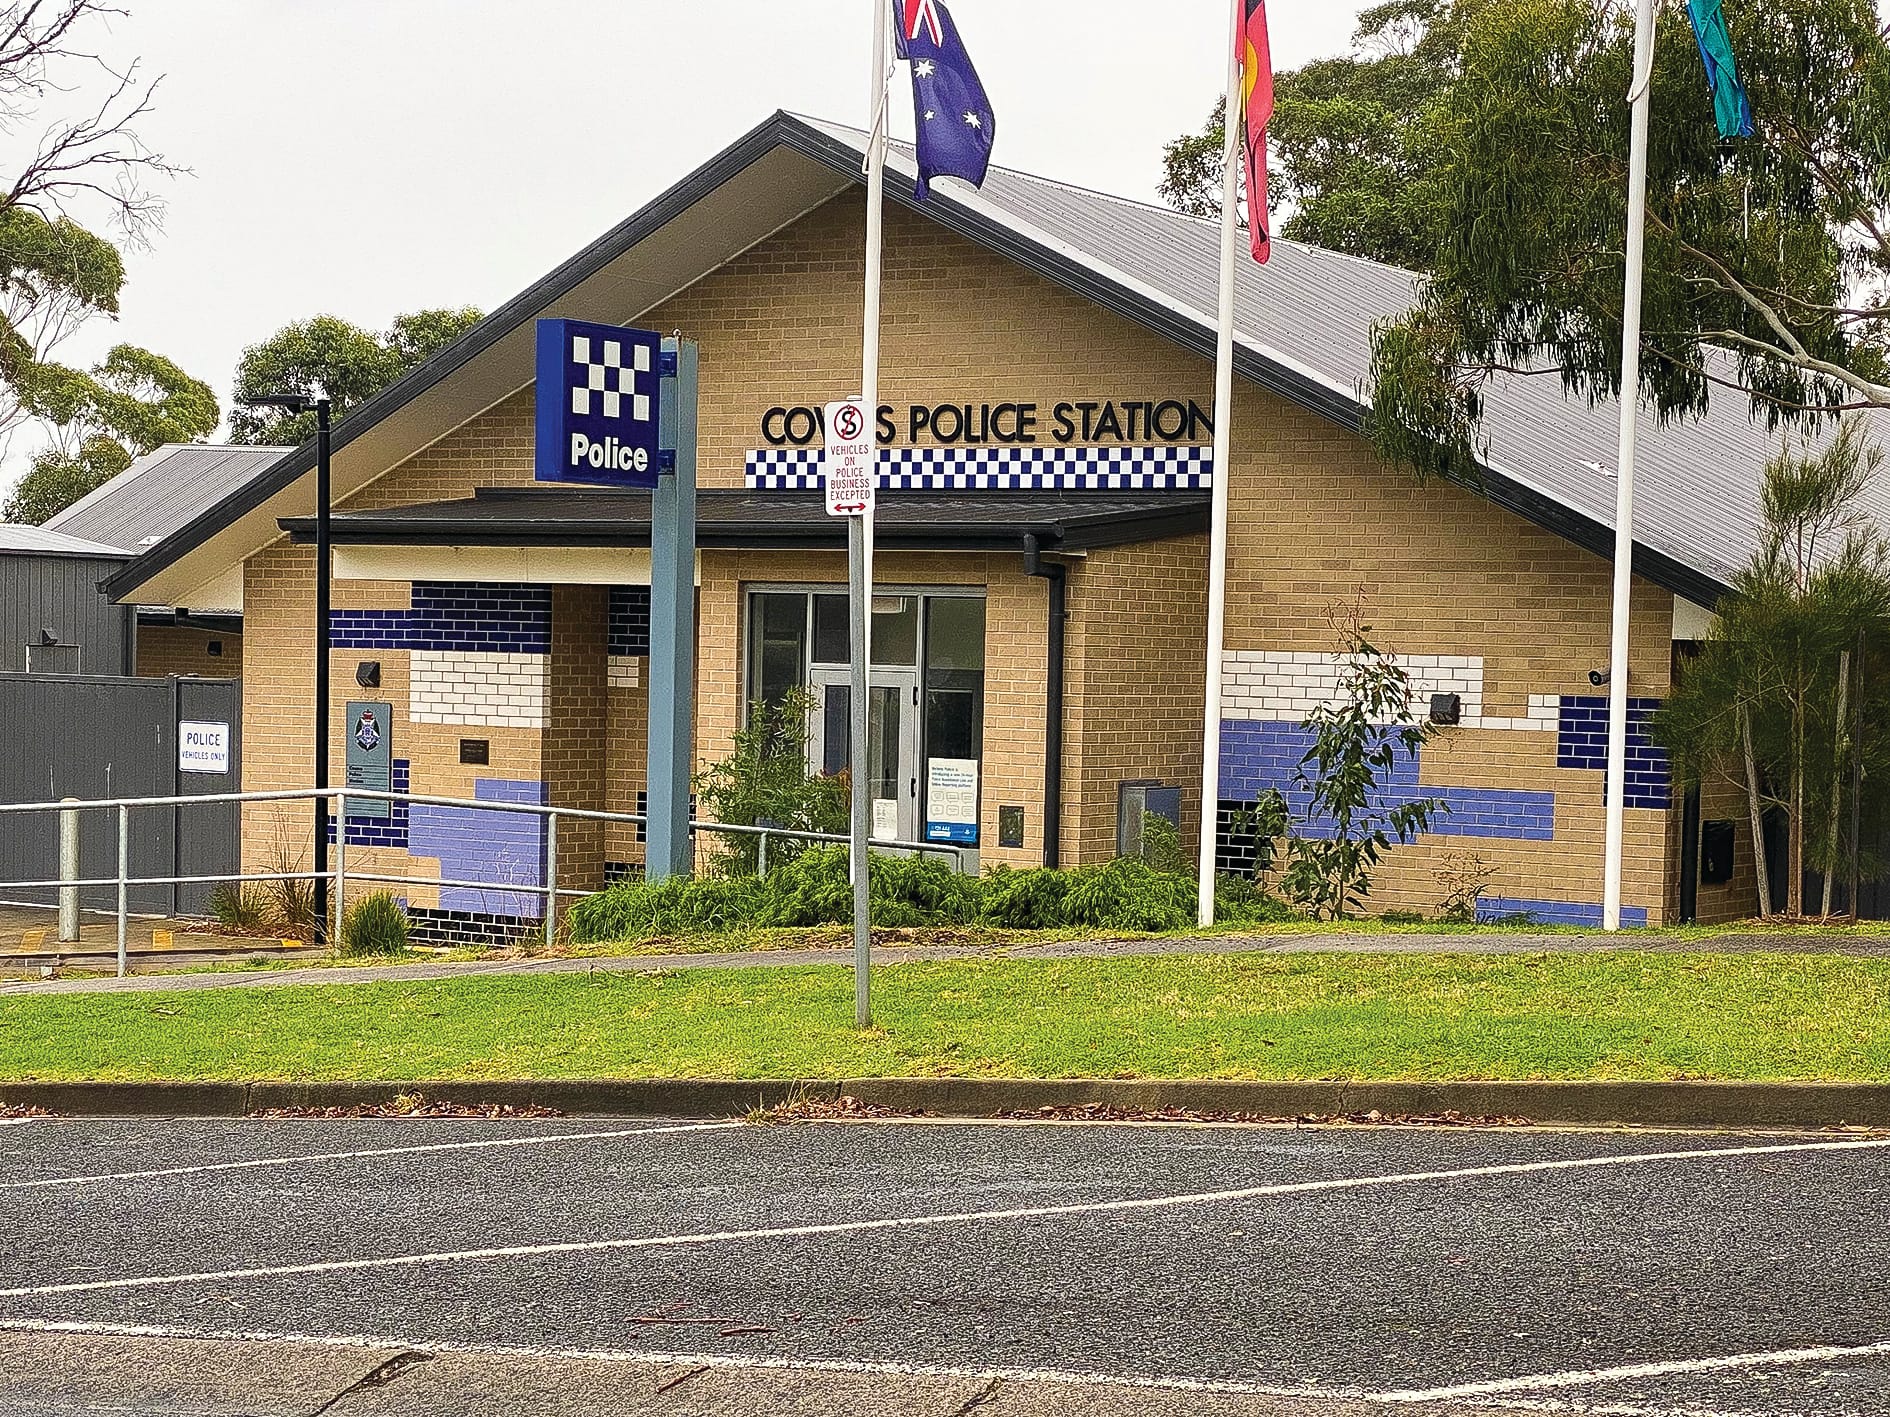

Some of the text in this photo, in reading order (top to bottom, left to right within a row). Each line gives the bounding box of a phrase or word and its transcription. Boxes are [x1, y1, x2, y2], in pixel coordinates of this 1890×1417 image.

[761, 399, 1215, 445] COS POLICE STATION
[571, 432, 649, 472] Police
[830, 444, 869, 456] VEHICLES
[844, 456, 855, 466] ON
[835, 467, 864, 478] POLICE
[830, 478, 870, 490] BUSINESS
[830, 489, 871, 501] EXCEPTED
[186, 732, 221, 747] POLICE
[182, 750, 226, 761] VEHICLES ONLY
